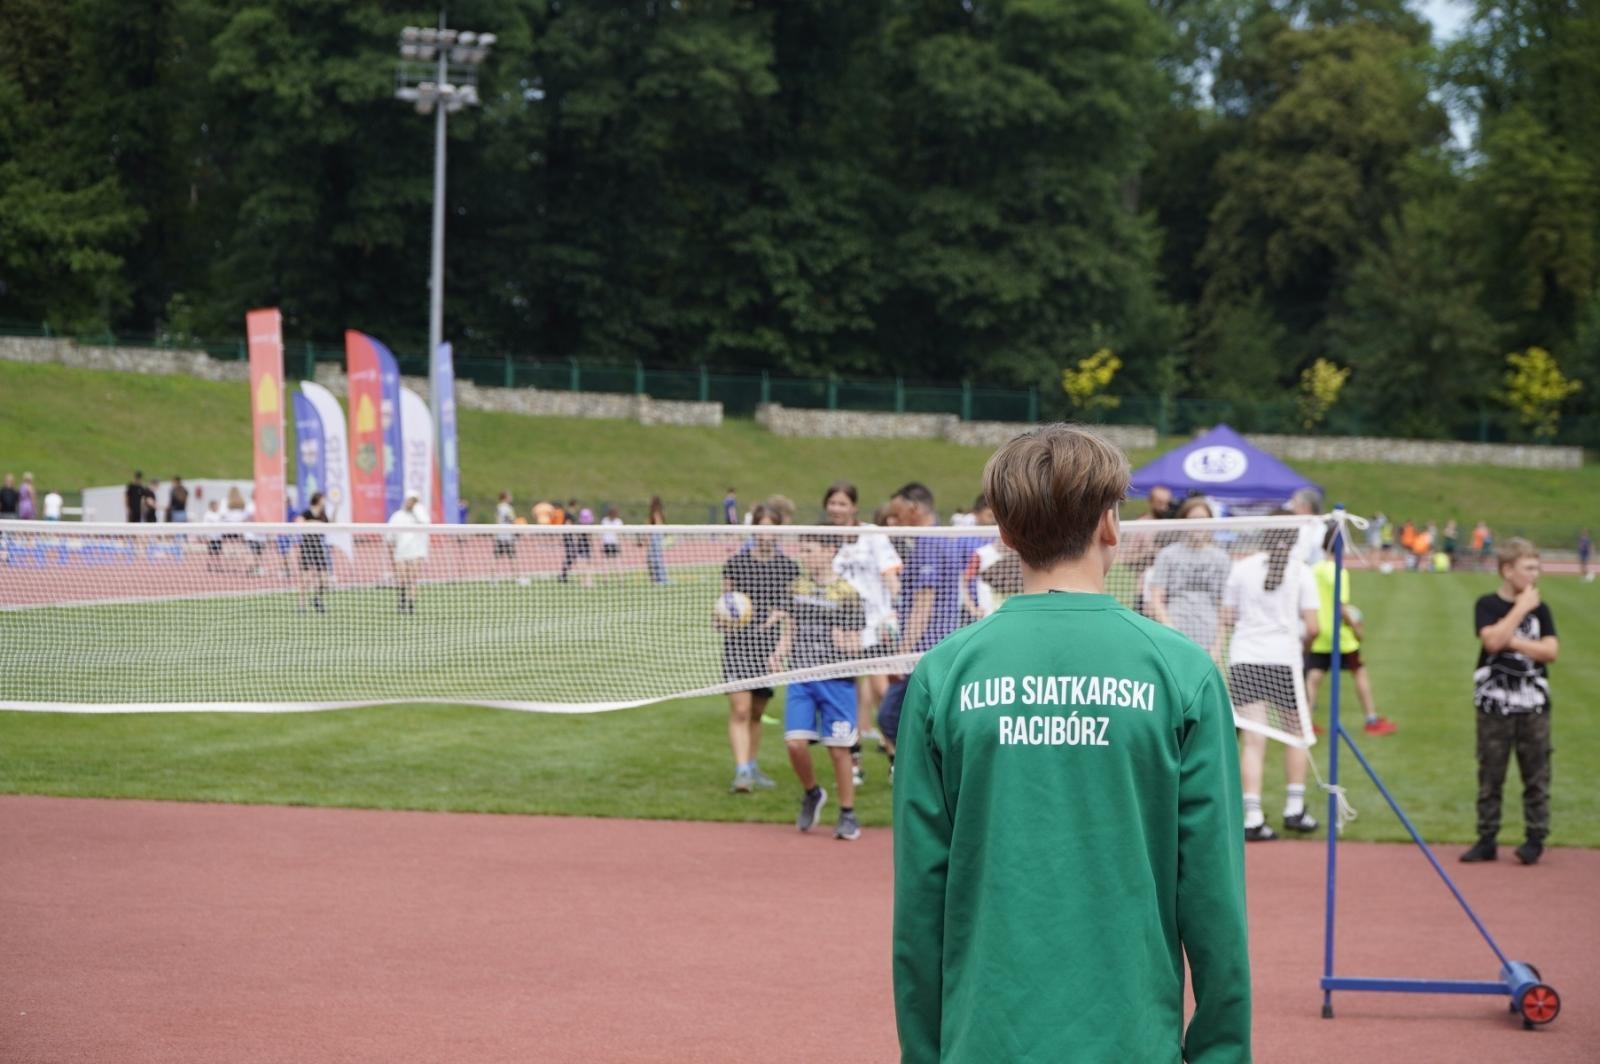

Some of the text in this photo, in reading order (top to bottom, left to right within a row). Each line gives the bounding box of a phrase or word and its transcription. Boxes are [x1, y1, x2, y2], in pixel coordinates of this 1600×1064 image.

[960, 676, 1154, 711] KLUB SIATKARSKI
[999, 711, 1109, 745] RACIBÓRZ
